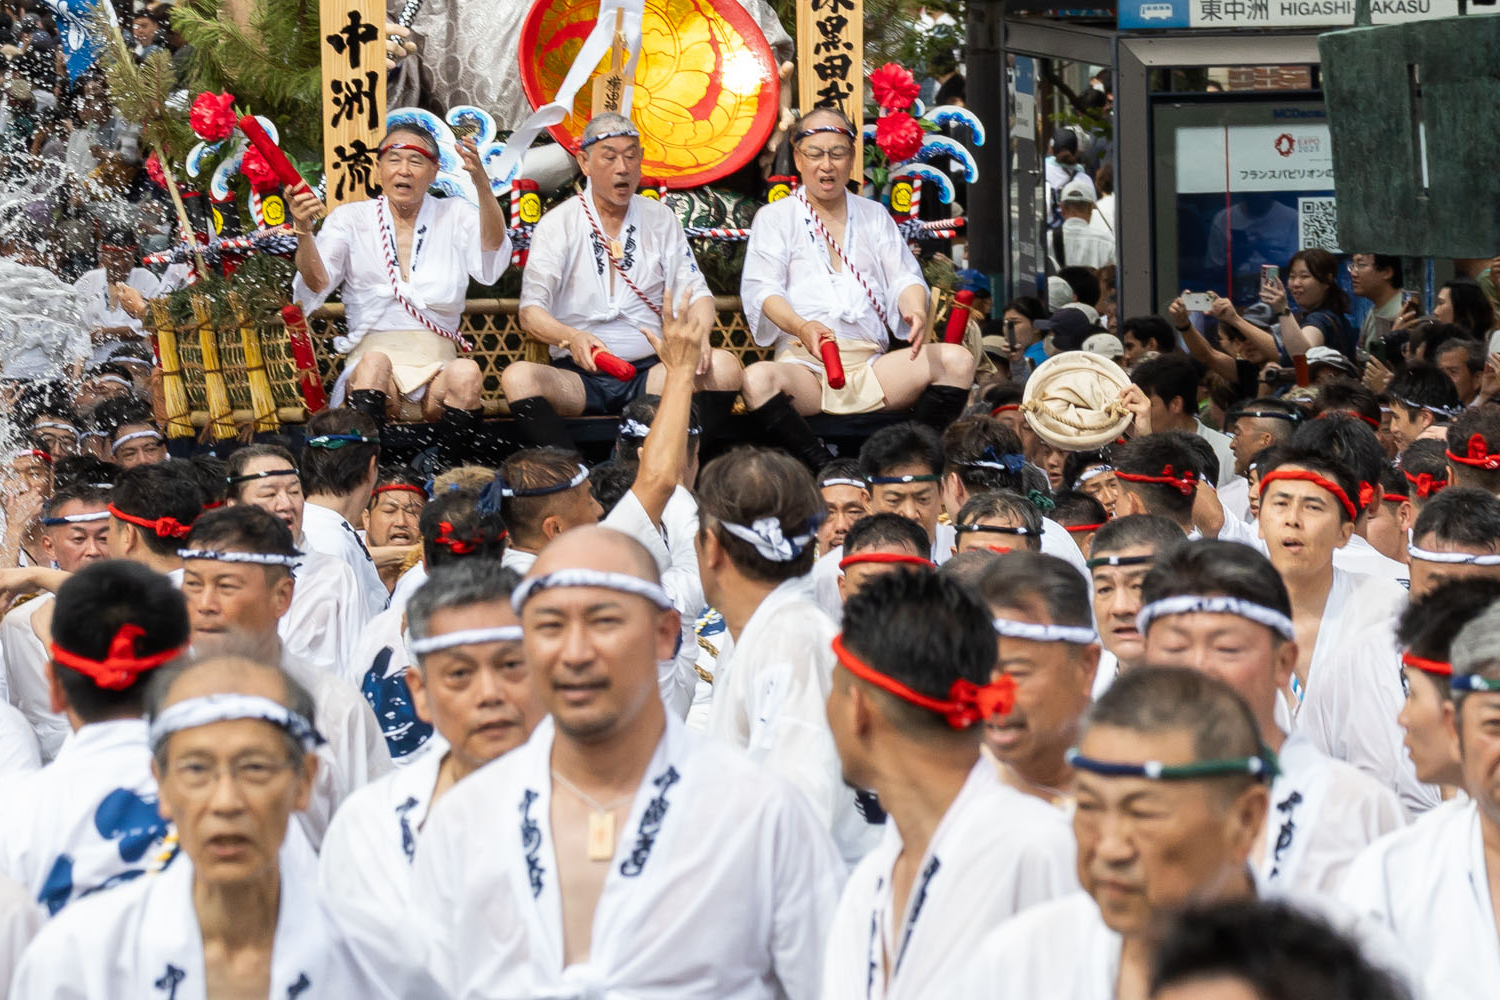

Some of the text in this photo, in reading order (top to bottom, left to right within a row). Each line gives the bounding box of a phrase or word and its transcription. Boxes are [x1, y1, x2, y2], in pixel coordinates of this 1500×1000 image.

[1280, 0, 1430, 17] HIGASHI-AKASU
[327, 10, 383, 201] 中洲流
[1240, 168, 1334, 180] フランスパビリオンの
